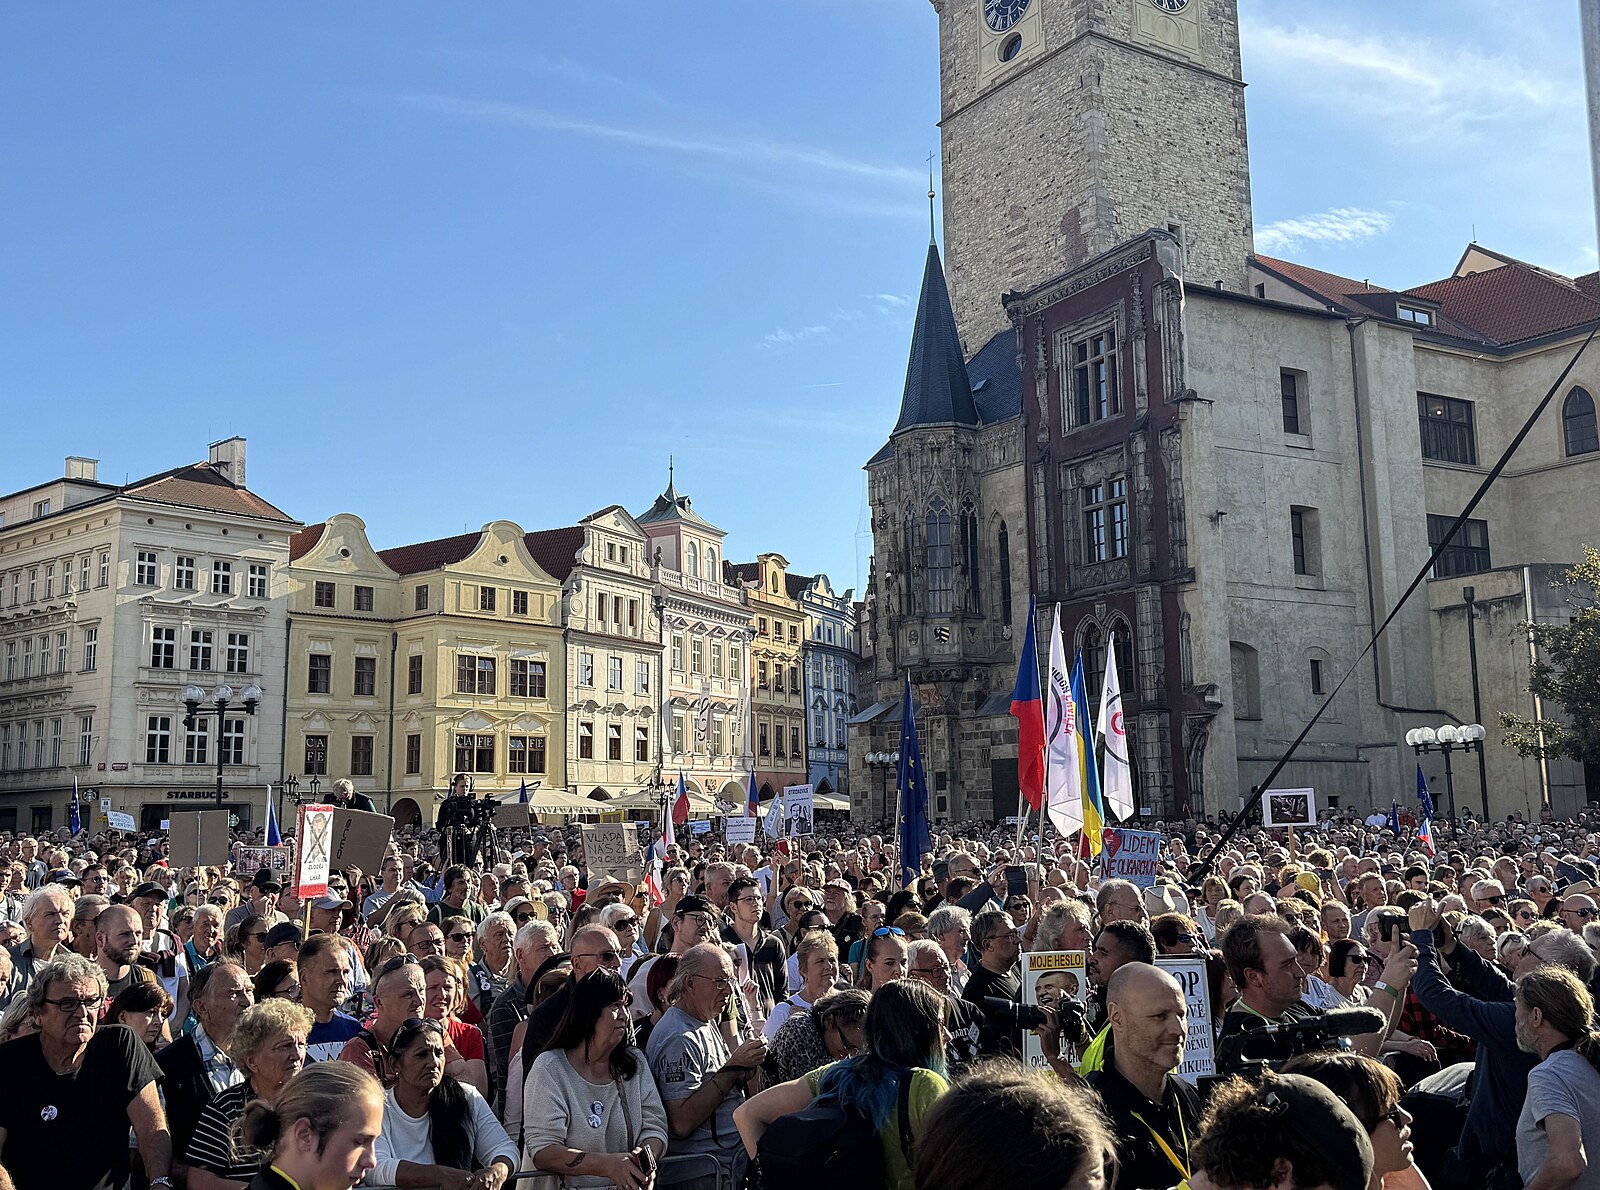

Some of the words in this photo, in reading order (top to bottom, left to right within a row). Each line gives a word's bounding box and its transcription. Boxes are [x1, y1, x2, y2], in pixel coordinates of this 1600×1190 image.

[167, 791, 229, 799] STARBUCS
[585, 831, 624, 842] VLÁDA
[587, 842, 614, 855] NÁS
[1122, 834, 1156, 854] LIDEM
[589, 855, 603, 866] DO
[1100, 858, 1117, 880] NE
[1030, 955, 1053, 968] MOJE
[1054, 953, 1084, 967] HESLO:
[1172, 971, 1200, 996] OP
[1187, 1023, 1207, 1035] CÍMU
[1179, 1059, 1211, 1074] TIKU!!!
